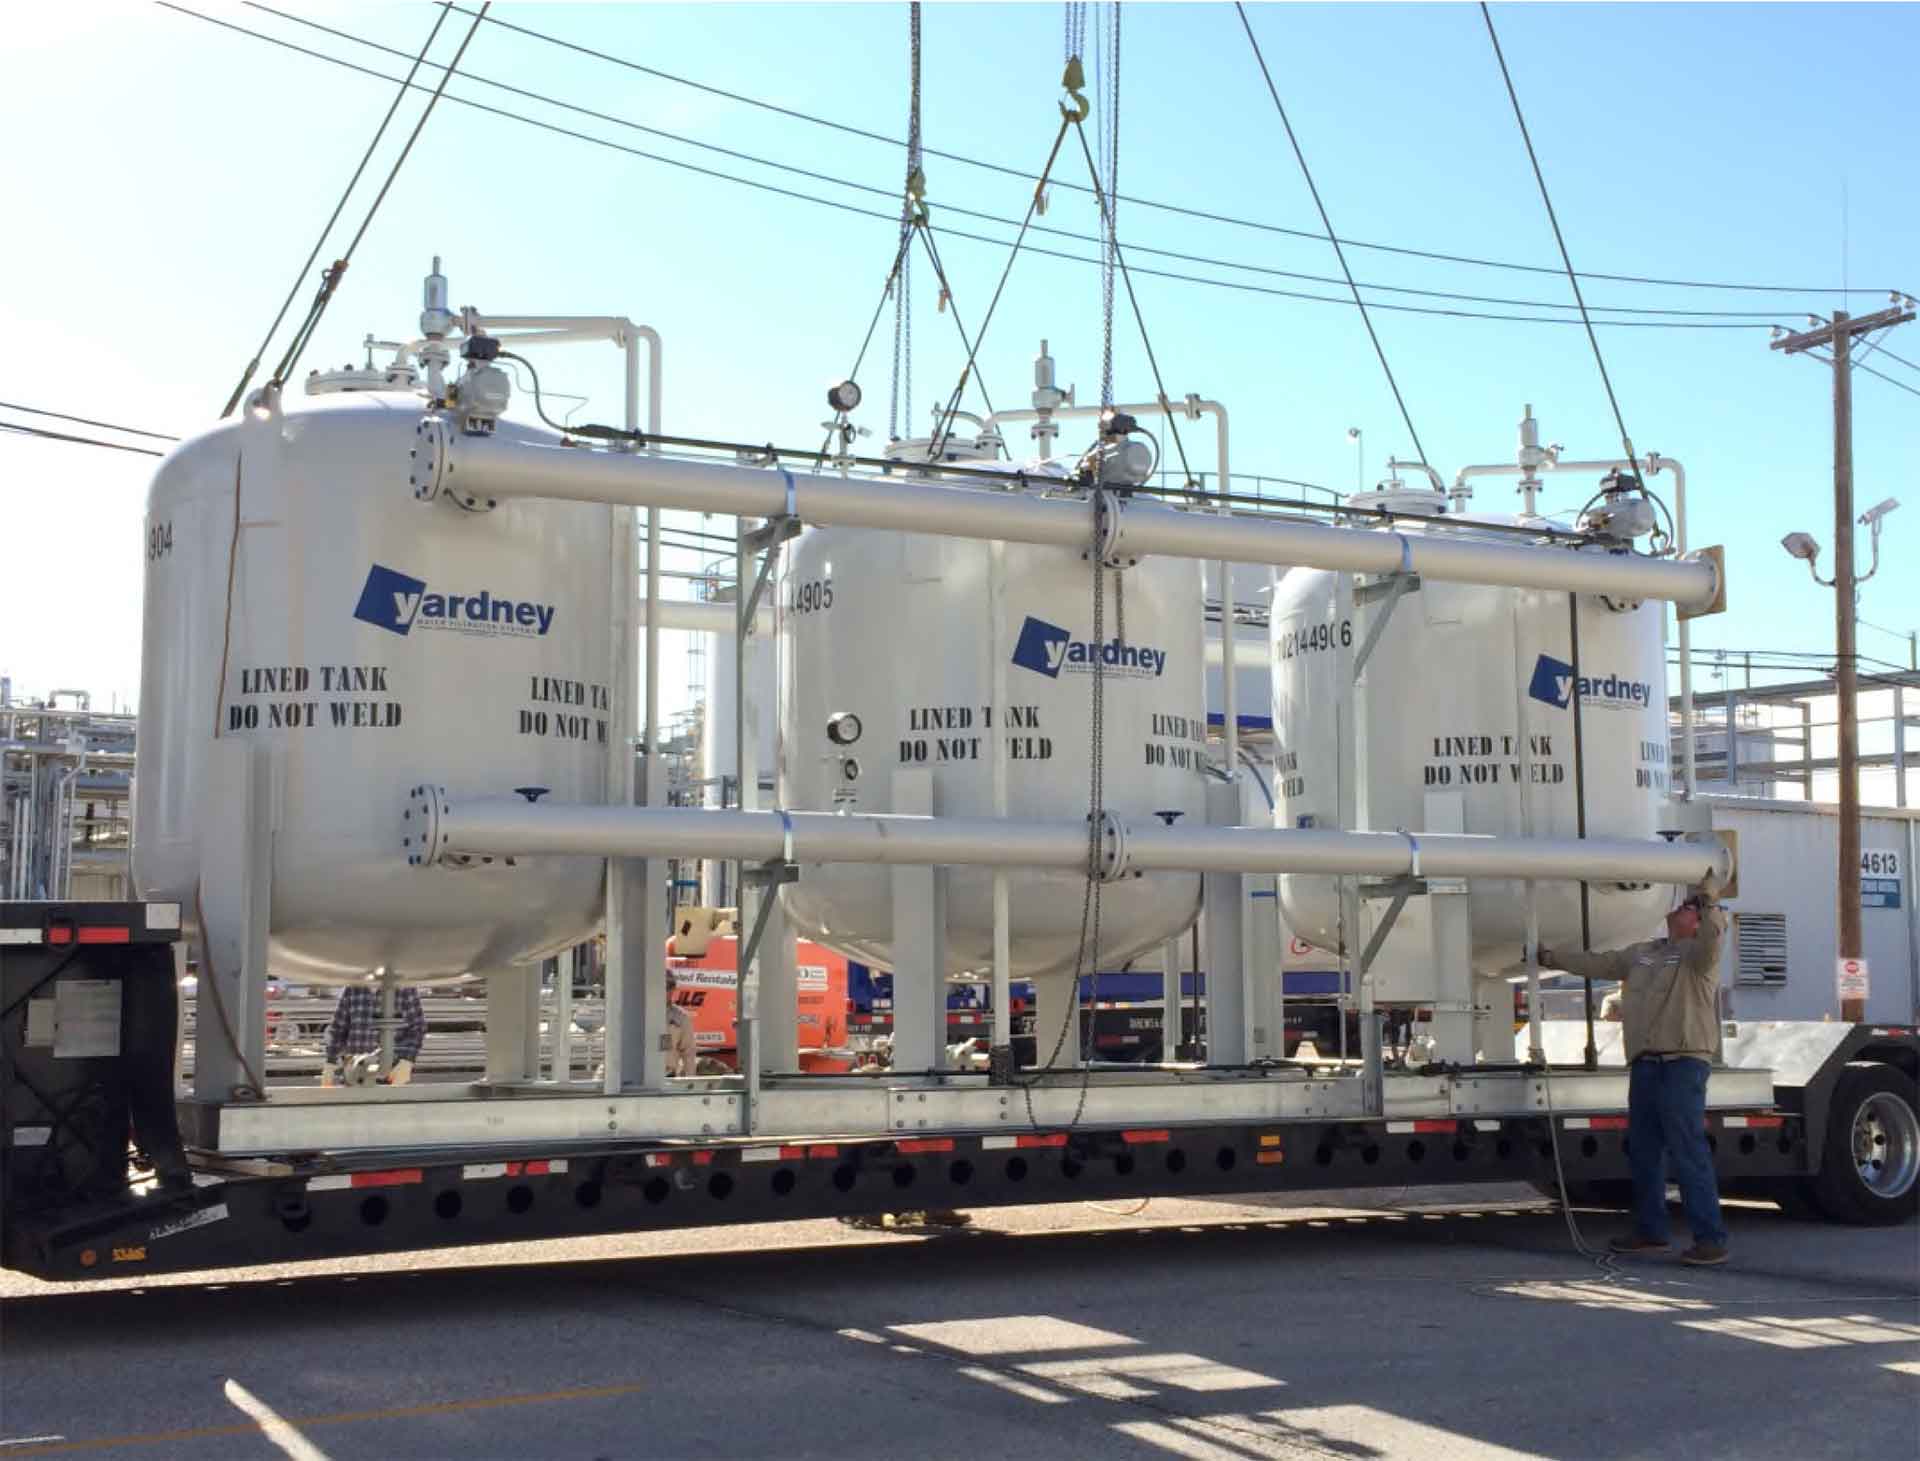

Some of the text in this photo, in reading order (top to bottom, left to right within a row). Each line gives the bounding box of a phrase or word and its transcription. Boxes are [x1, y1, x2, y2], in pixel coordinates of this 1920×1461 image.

[242, 665, 388, 694] LINED TANK
[531, 676, 585, 706] LINED
[229, 702, 402, 731] DO NOT WELD
[519, 709, 548, 736] DO
[555, 712, 591, 742] NOT
[910, 705, 1040, 731] LINED TNK
[899, 737, 1053, 763] DO NOT ELD
[1144, 743, 1166, 768] DO
[1433, 736, 1494, 758] LINED
[1424, 764, 1452, 785] DO
[1459, 763, 1502, 784] NOT
[1861, 853, 1898, 875] 4613
[675, 991, 707, 1007] JLG
